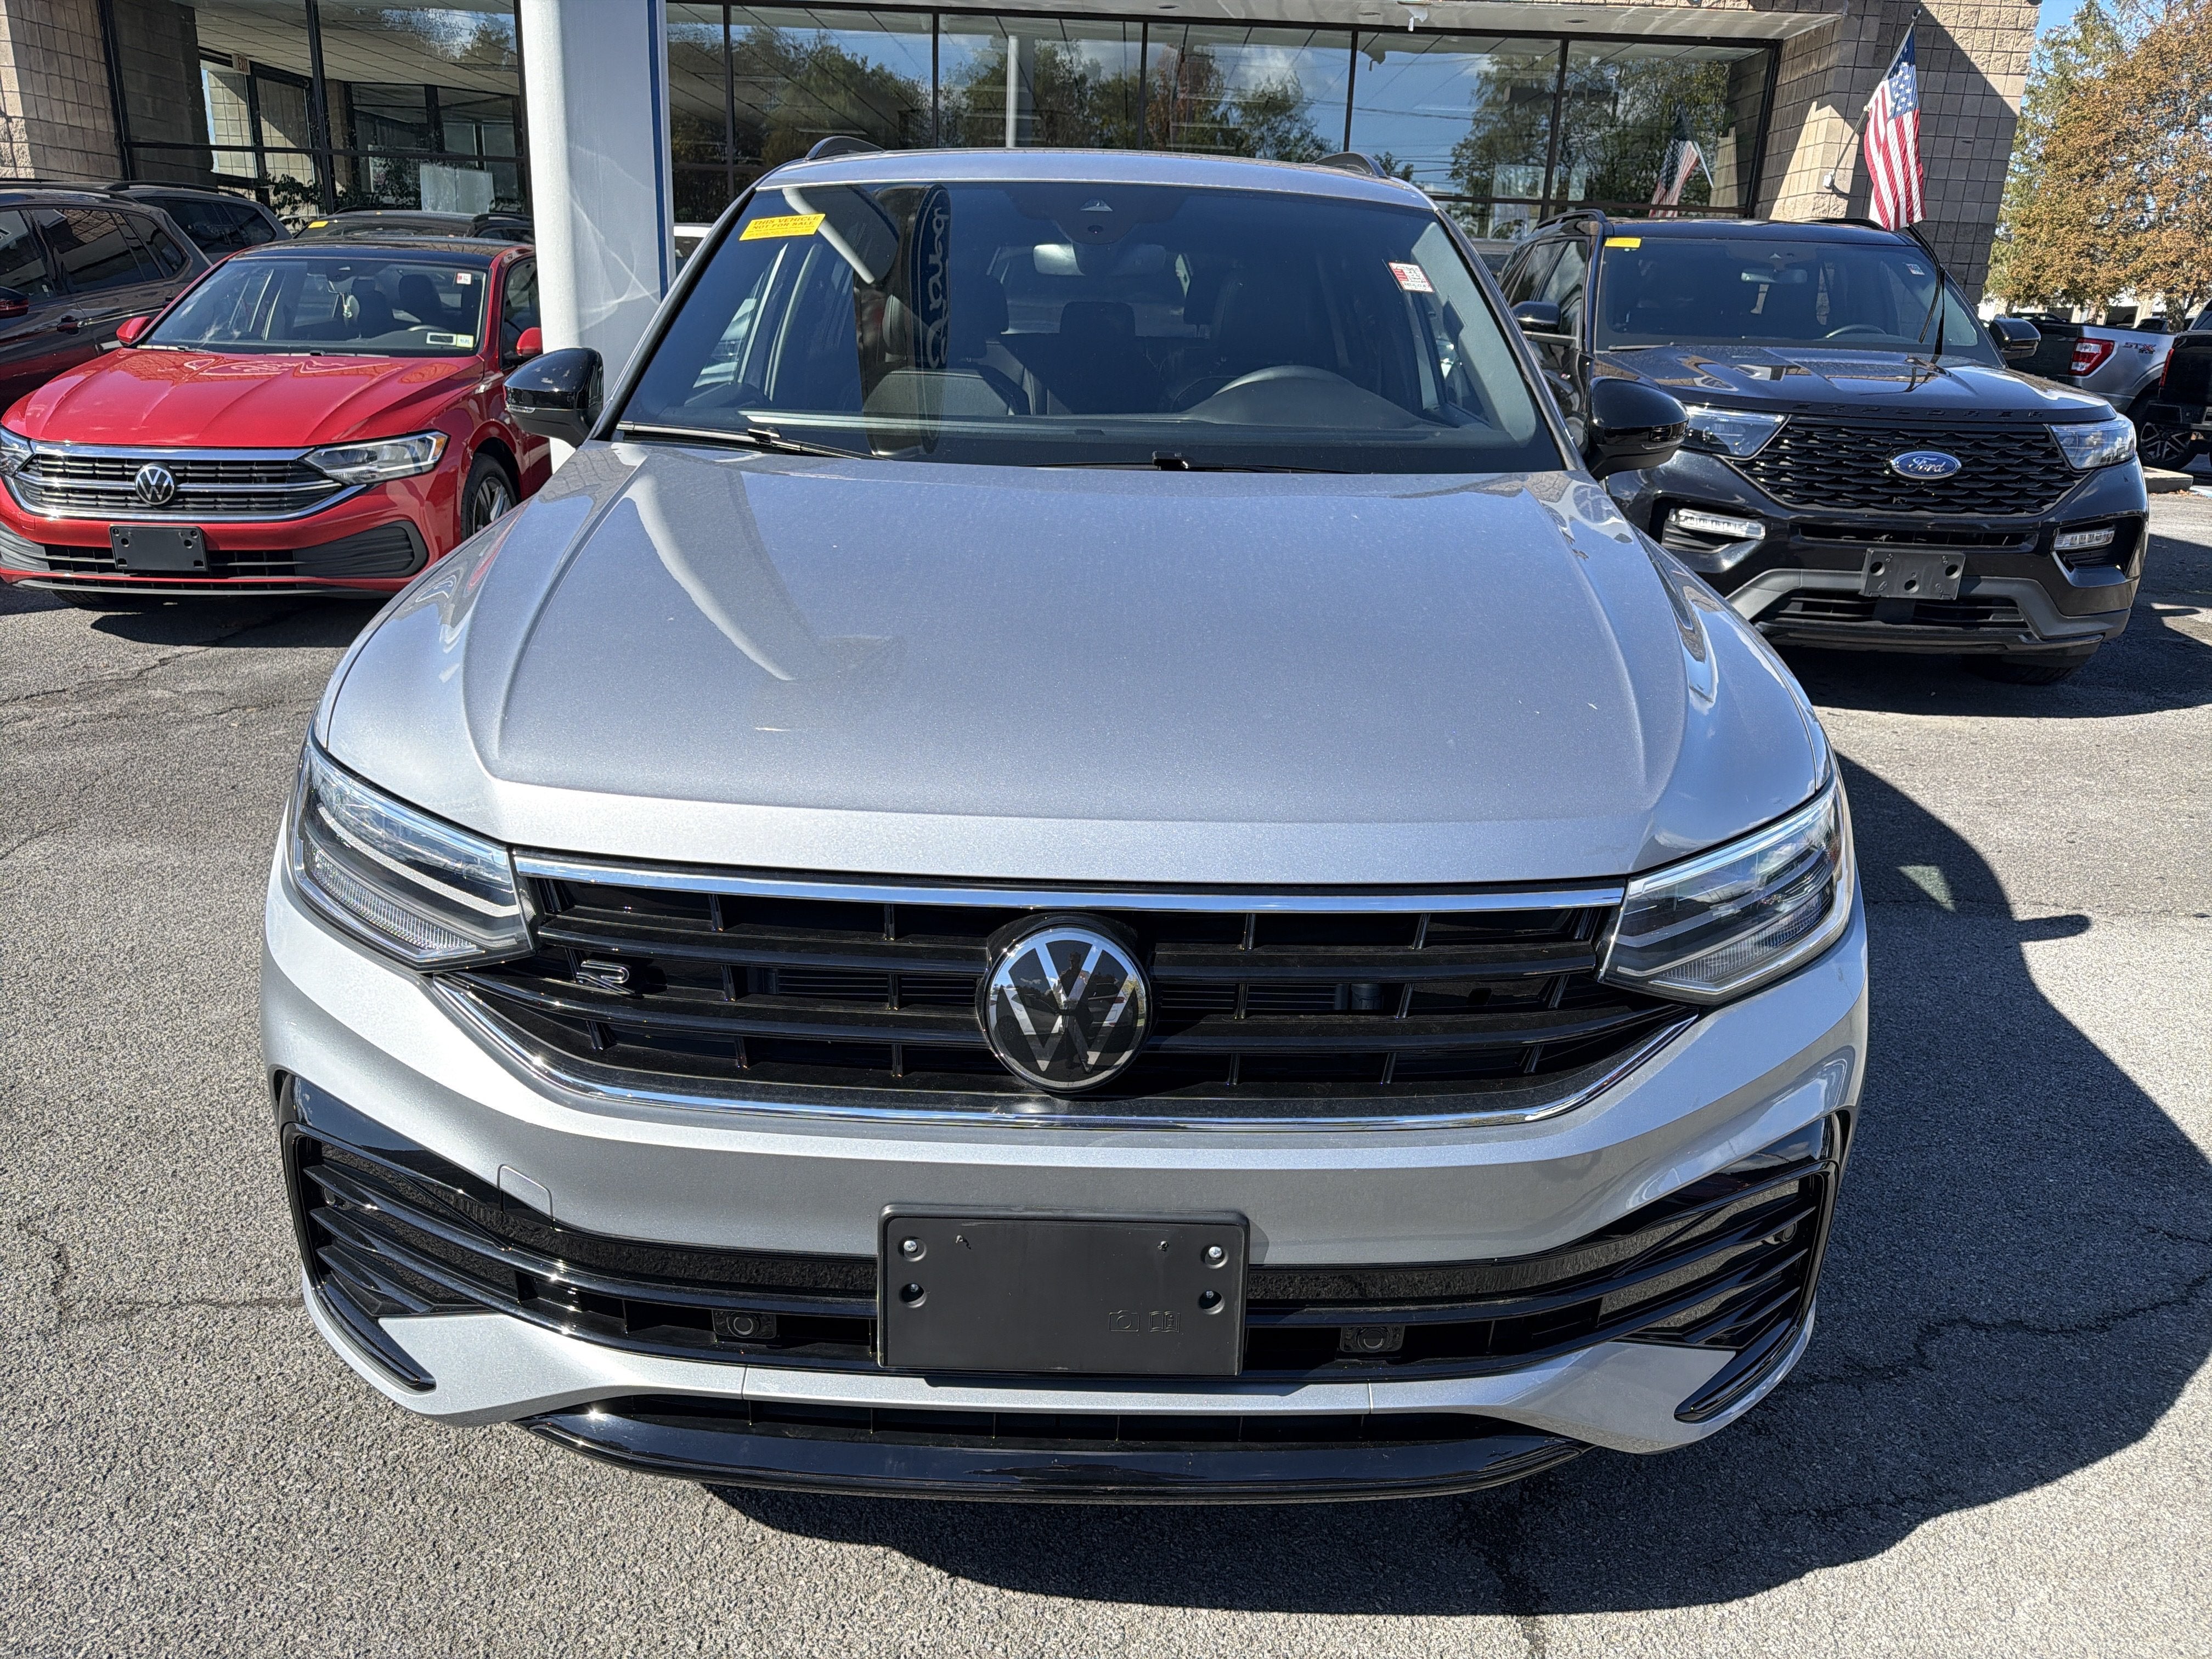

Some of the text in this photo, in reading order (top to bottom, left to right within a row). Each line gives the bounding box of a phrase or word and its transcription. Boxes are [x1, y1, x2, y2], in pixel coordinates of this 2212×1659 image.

[1909, 456, 1946, 473] Ford
[137, 467, 172, 503] VW
[994, 932, 1141, 1080] VW
